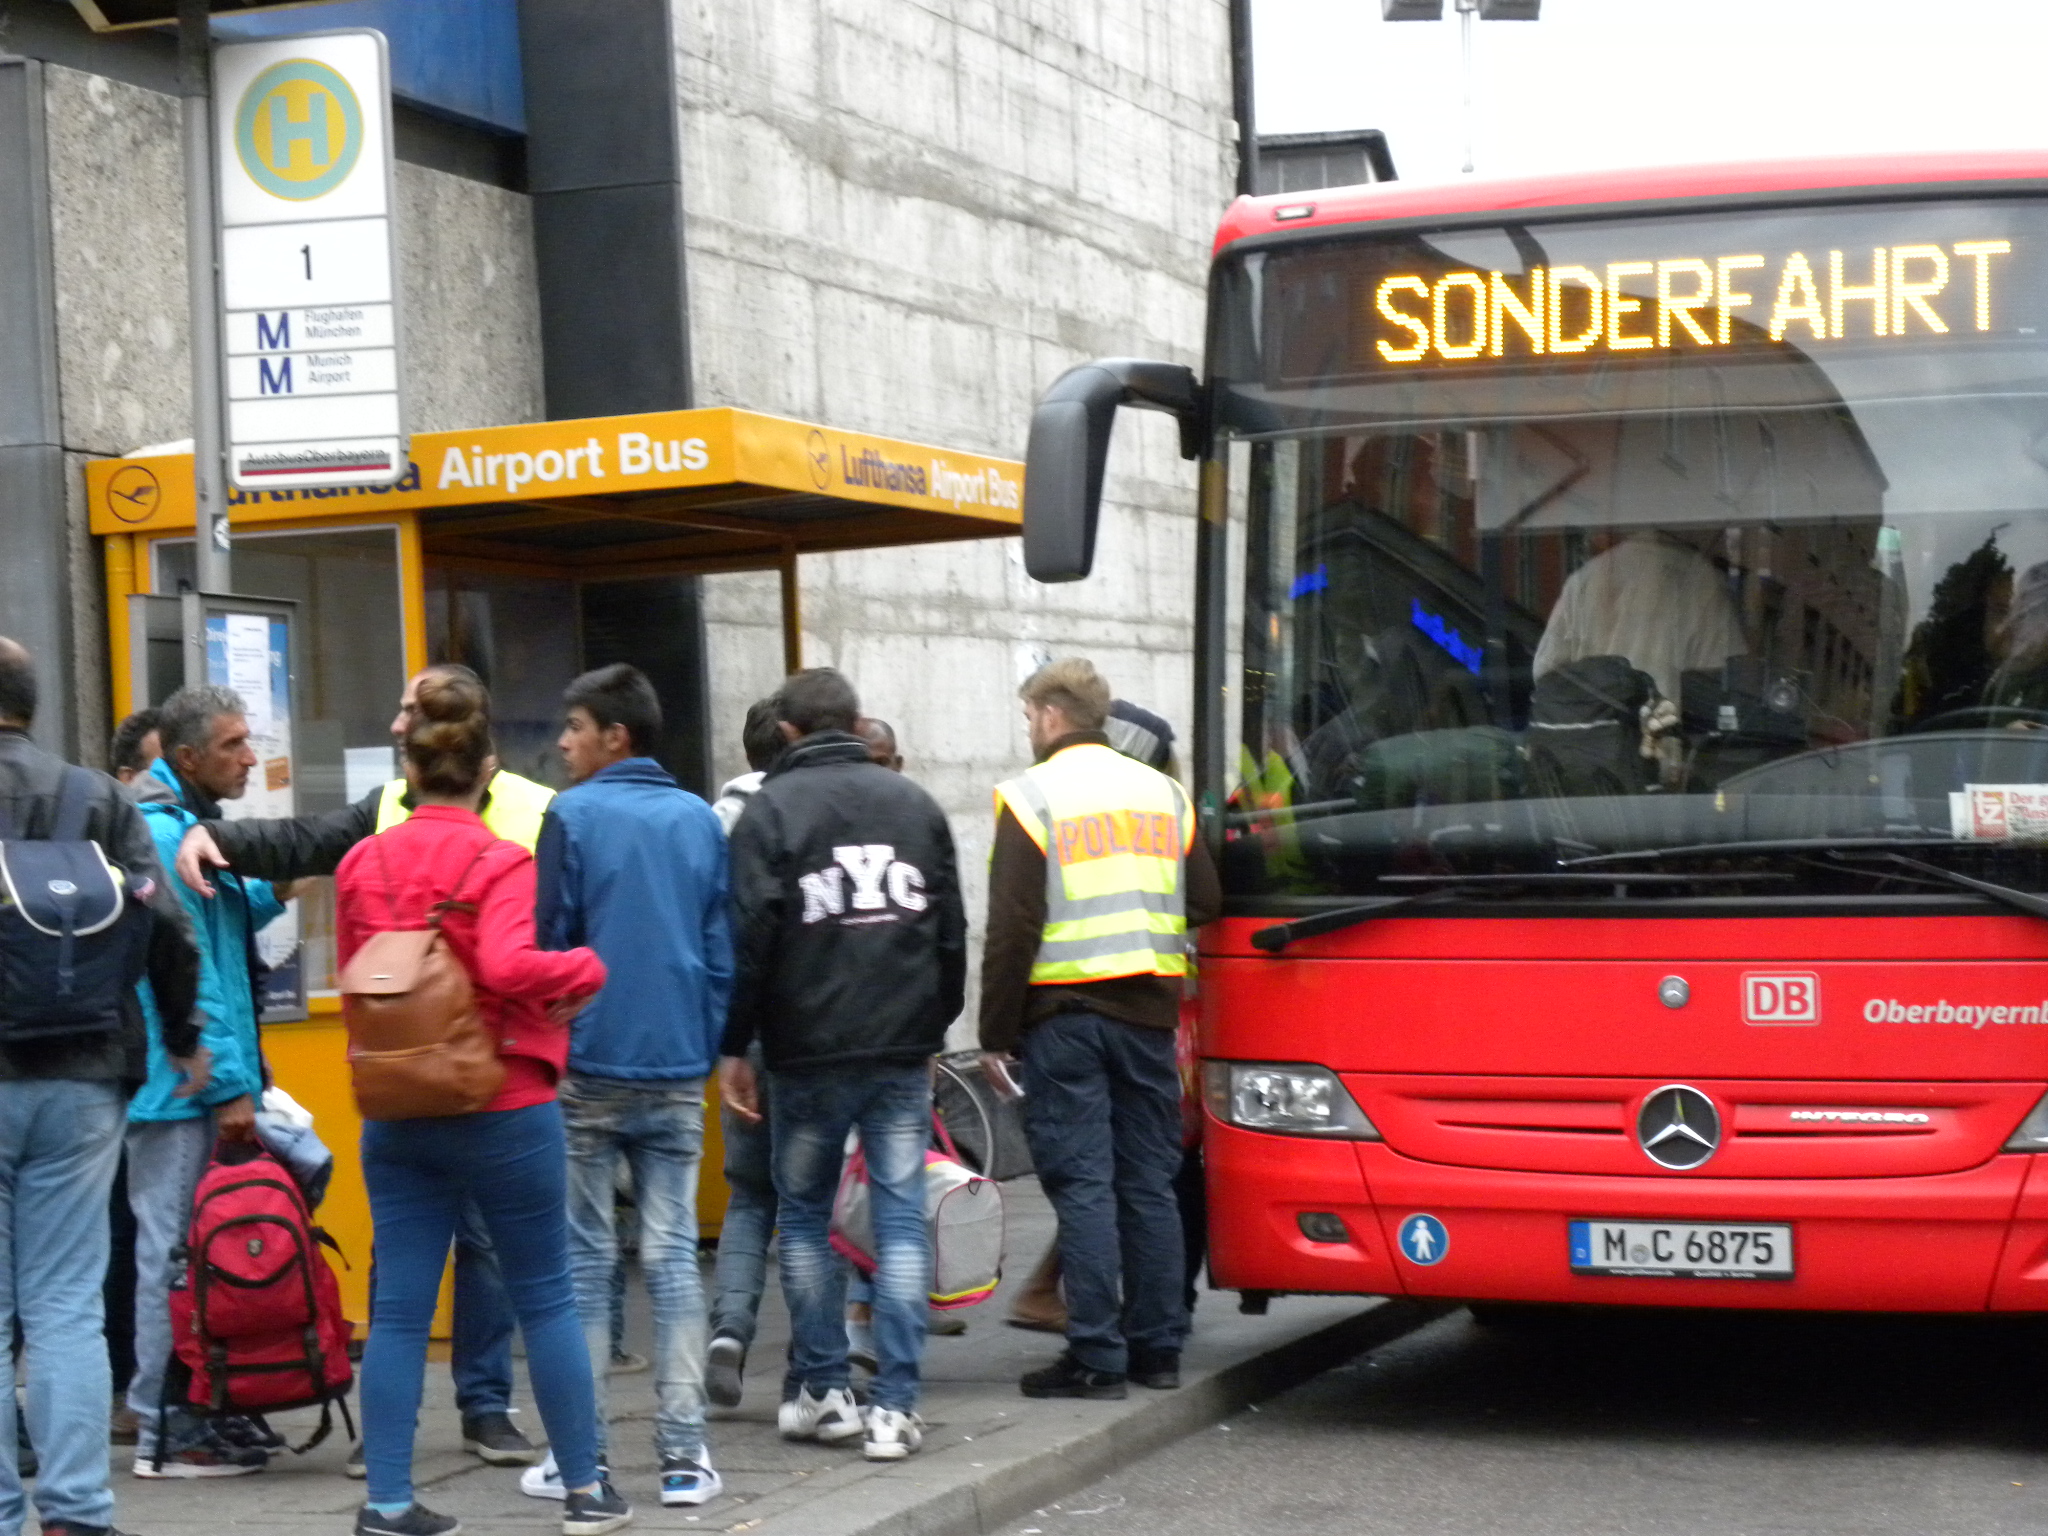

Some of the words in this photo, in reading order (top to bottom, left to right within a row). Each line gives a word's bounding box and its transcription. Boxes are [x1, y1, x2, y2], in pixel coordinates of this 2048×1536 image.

[269, 92, 330, 168] H
[300, 244, 313, 280] 1
[304, 308, 364, 324] Flughafen
[1376, 240, 2012, 362] SONDERFAHRT
[257, 312, 290, 350] M
[304, 325, 362, 338] München
[260, 357, 293, 395] M
[306, 354, 353, 367] Munich
[308, 371, 351, 385] Airport
[437, 436, 605, 493] Airport
[617, 431, 710, 476] Bus
[840, 443, 928, 496] Lufthansa
[930, 458, 988, 510] Airport
[988, 466, 1019, 510] Bus
[1060, 812, 1175, 863] POLZEI
[799, 844, 928, 924] NYC
[1752, 980, 1810, 1015] DB
[1603, 1228, 1627, 1261] M
[1652, 1229, 1675, 1262] C
[1684, 1230, 1774, 1265] 6875
